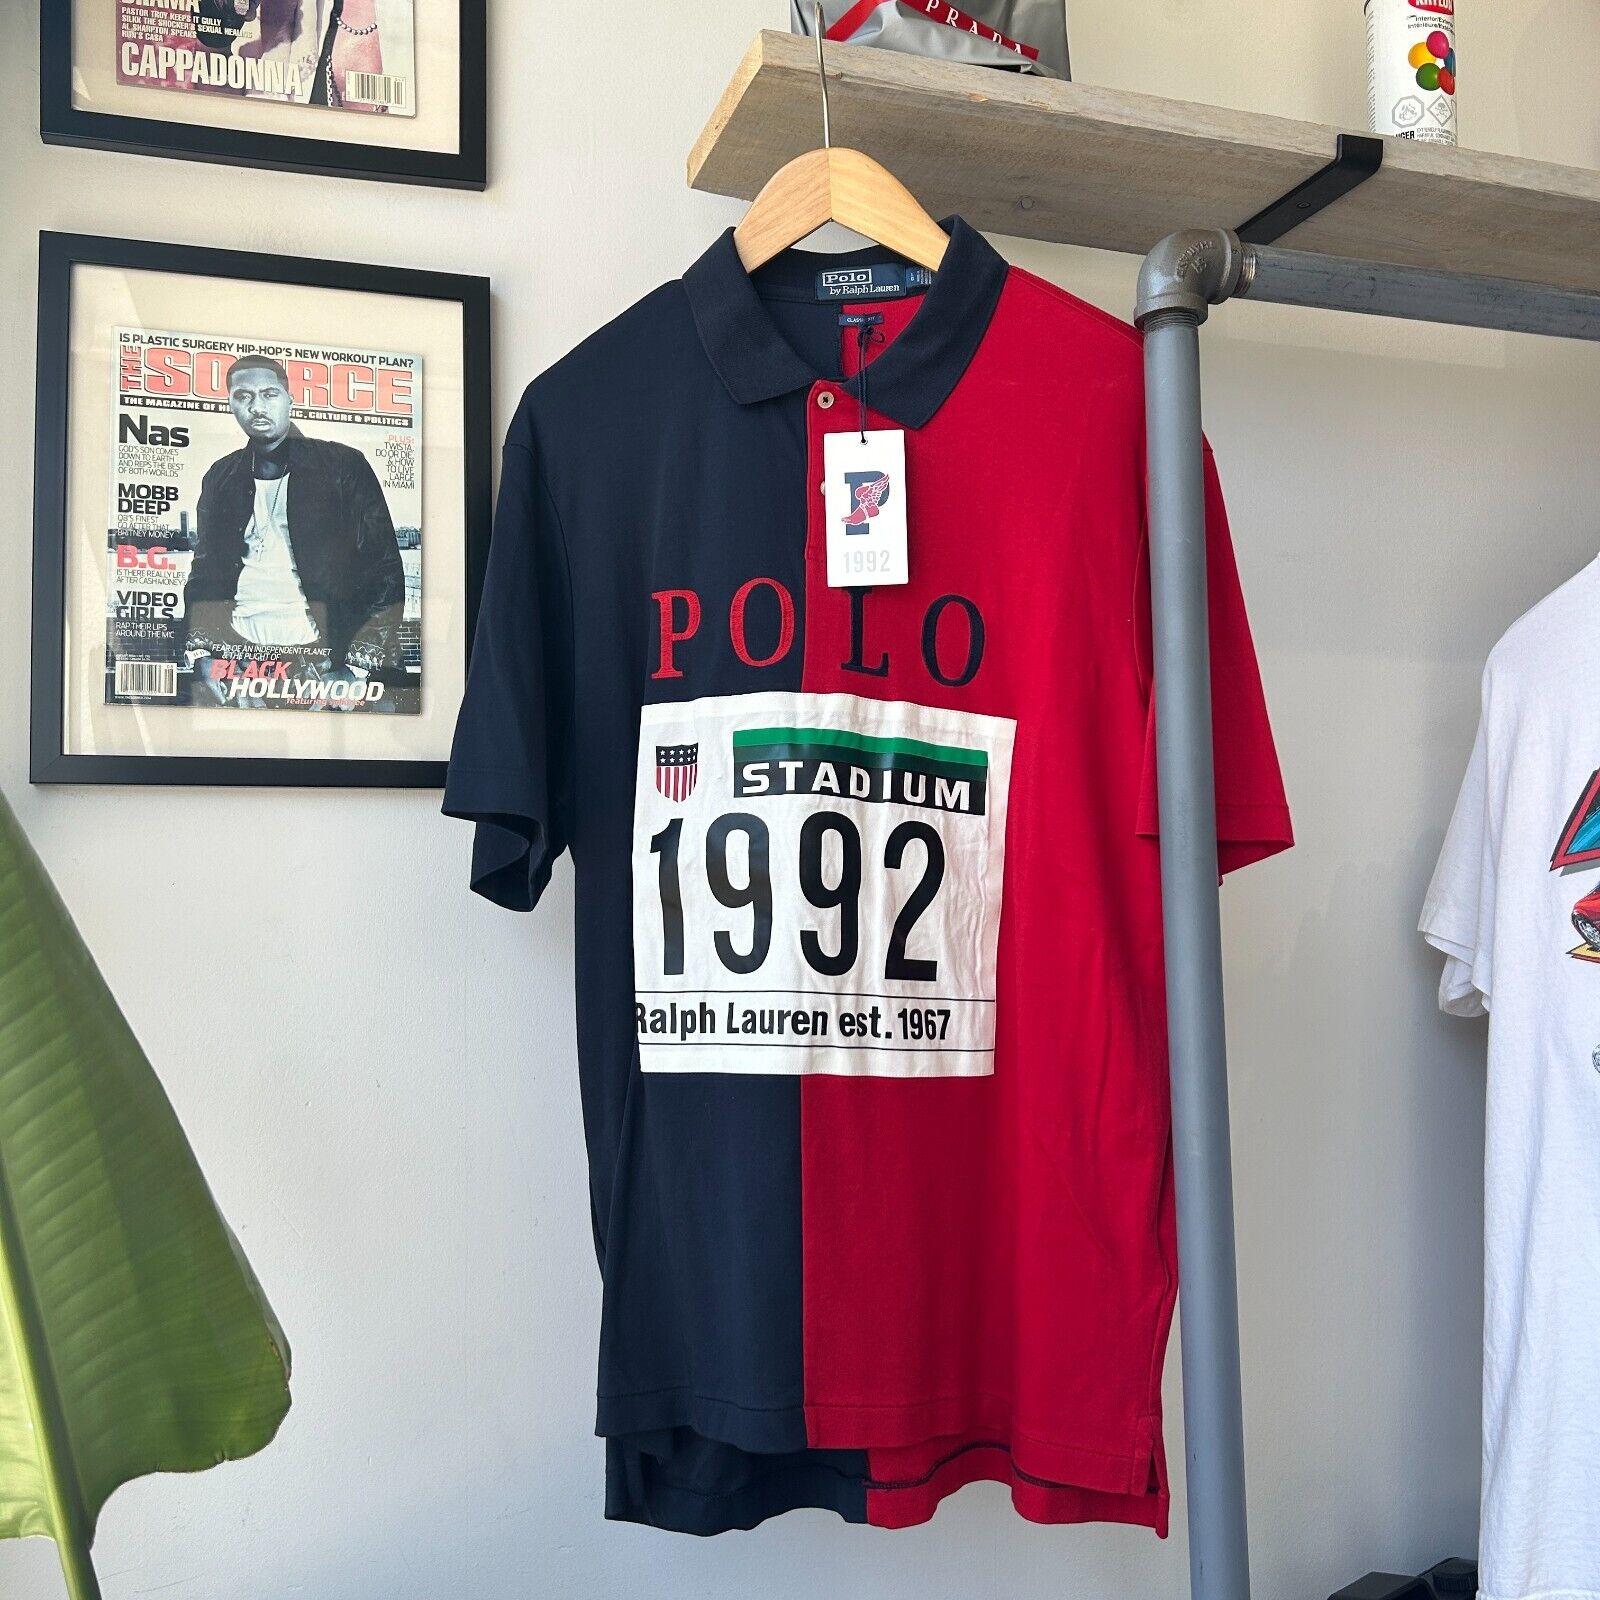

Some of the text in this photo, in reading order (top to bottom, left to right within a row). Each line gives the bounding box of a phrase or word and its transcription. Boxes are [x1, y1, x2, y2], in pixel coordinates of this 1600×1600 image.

[121, 7, 148, 17] PASTOR
[151, 10, 168, 19] TROY
[170, 12, 192, 22] KEEPS
[193, 15, 200, 24] IT
[121, 23, 130, 31] AL
[170, 29, 197, 39] SPEAKS
[144, 17, 156, 26] THE
[198, 24, 222, 35] SEXUAL
[925, 0, 1023, 54] PRADA
[121, 41, 303, 97] CAPPADONNA
[825, 272, 867, 284] Polo
[829, 284, 900, 296] by Ralph Lauren
[119, 332, 414, 368] IS PLASTIC SURGERY HIP-HOP'S NEW WORKOUT PLAN?
[120, 345, 142, 393] THE
[144, 347, 413, 416] SORCE
[123, 396, 144, 405] THE
[146, 398, 200, 410] MAGAZINE
[202, 403, 216, 411] OF
[308, 411, 353, 422] CULTURE
[354, 415, 362, 423] &
[364, 417, 409, 427] POLITICS
[118, 413, 190, 448] Nas
[118, 451, 175, 463] DOWN TO EARTH
[140, 446, 154, 455] SON
[155, 447, 179, 456] COMES
[375, 448, 387, 458] DO
[388, 449, 399, 458] OR
[118, 459, 185, 471] AND REPS THE BEST
[386, 464, 414, 474] TO LIVE
[395, 458, 414, 467] HOW
[118, 466, 179, 478] OF BOTH WORLDS
[118, 482, 179, 501] MOBB
[382, 480, 415, 490] IN MIAMI
[117, 497, 171, 515] DEEP
[148, 530, 175, 539] MONEY
[117, 544, 177, 571] B.G.
[843, 550, 891, 574] 1992
[116, 568, 186, 579] IS THERE REALLY LIFE
[116, 576, 139, 584] AFTER
[116, 590, 179, 608] VIDEO
[115, 605, 174, 621] GIRLS
[115, 621, 168, 631] RAP THEIR LIPS
[115, 629, 175, 639] AROUND THE MIC
[651, 577, 986, 688] POLO
[211, 643, 332, 657] FEAR OF AN INDEPENDENT PLANET
[229, 652, 243, 660] THE
[270, 653, 281, 661] OF
[210, 658, 292, 681] BLACK
[228, 677, 385, 702] HOLLYWOOD
[741, 761, 971, 812] STADIUM
[649, 811, 946, 982] 1992
[635, 1002, 951, 1042] Ralph Lauren est. 1967
